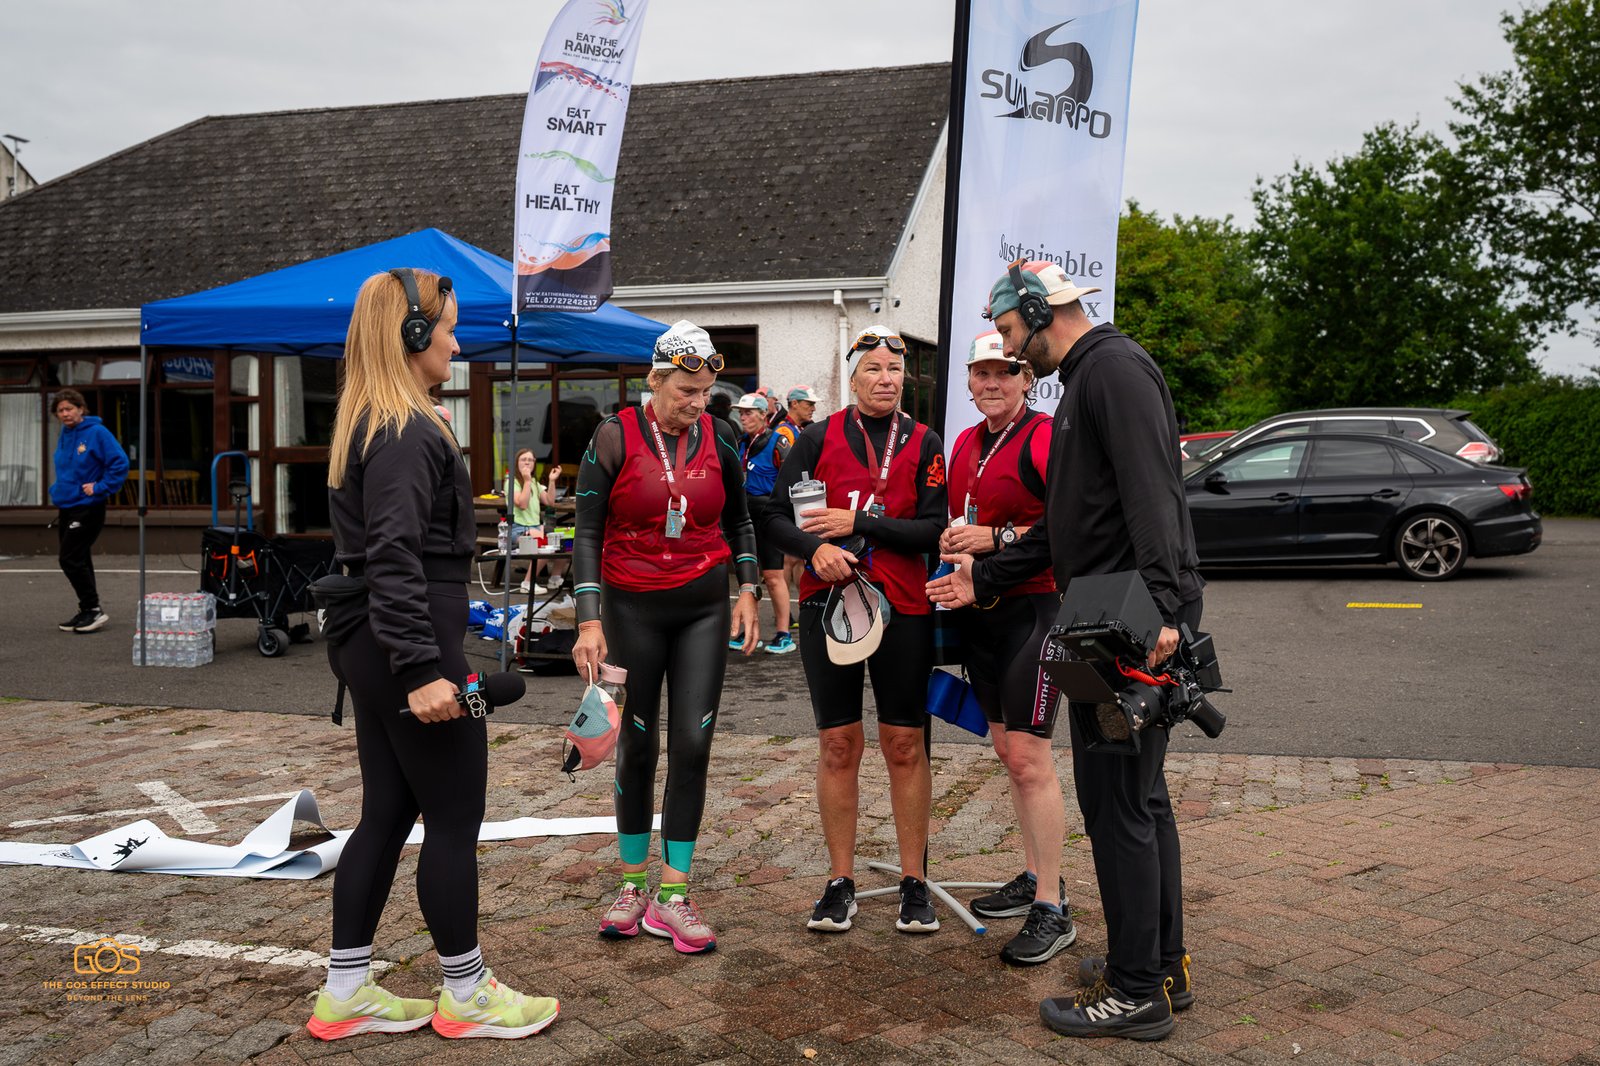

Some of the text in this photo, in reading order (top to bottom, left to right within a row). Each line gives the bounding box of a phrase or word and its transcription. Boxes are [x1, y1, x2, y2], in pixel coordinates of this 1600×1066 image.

[576, 32, 618, 47] EAT THE
[564, 39, 624, 59] RAINBOW
[567, 107, 591, 119] EAT
[546, 116, 607, 136] SMART
[553, 183, 580, 195] EAT
[525, 194, 600, 215] HEALTHY
[999, 233, 1103, 278] Sustainable
[1054, 645, 1064, 661] LUB
[1038, 641, 1056, 721] SOUTH CAST
[1126, 1001, 1152, 1017] SALOMON
